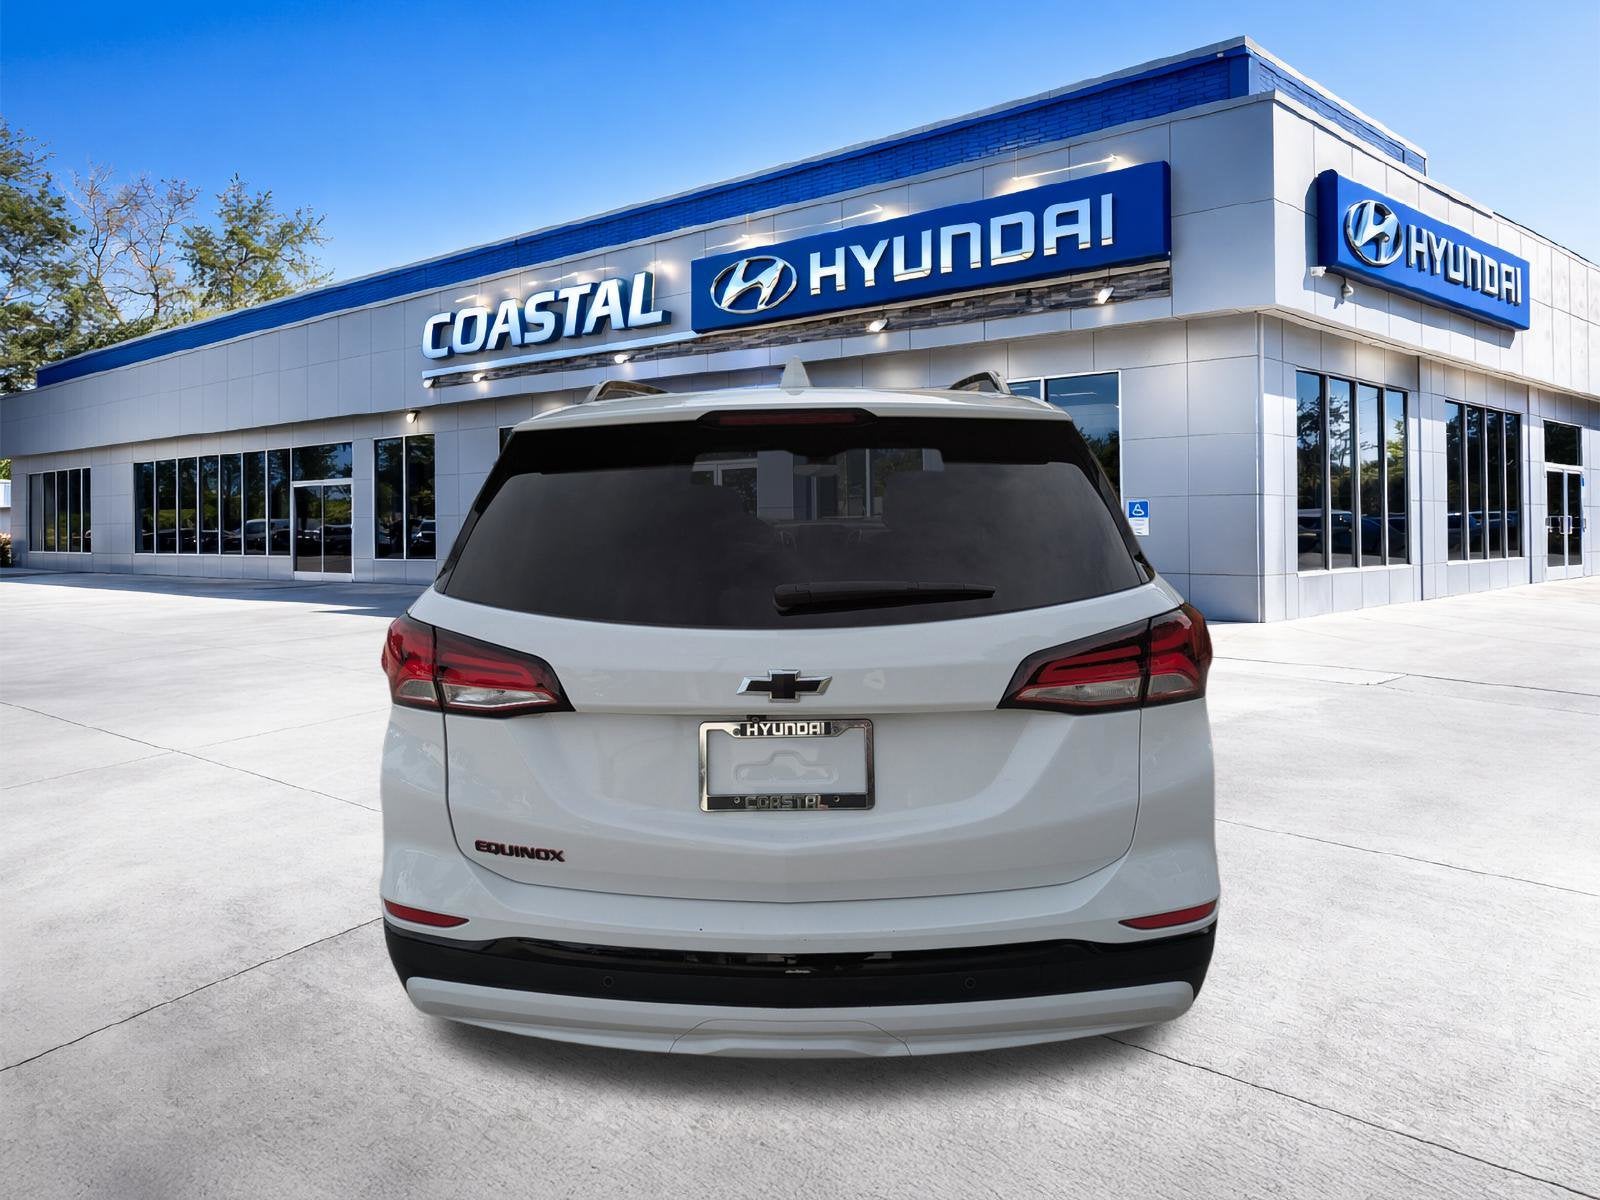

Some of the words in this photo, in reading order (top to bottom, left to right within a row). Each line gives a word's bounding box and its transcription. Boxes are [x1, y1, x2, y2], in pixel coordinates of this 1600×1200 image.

[809, 192, 1114, 295] HYUNDAI
[1406, 224, 1522, 306] HYUNDAI
[421, 270, 670, 360] COASTAL
[746, 722, 825, 736] HYUNDAI
[745, 796, 828, 809] COASTAL
[475, 840, 565, 862] EQUINOX
